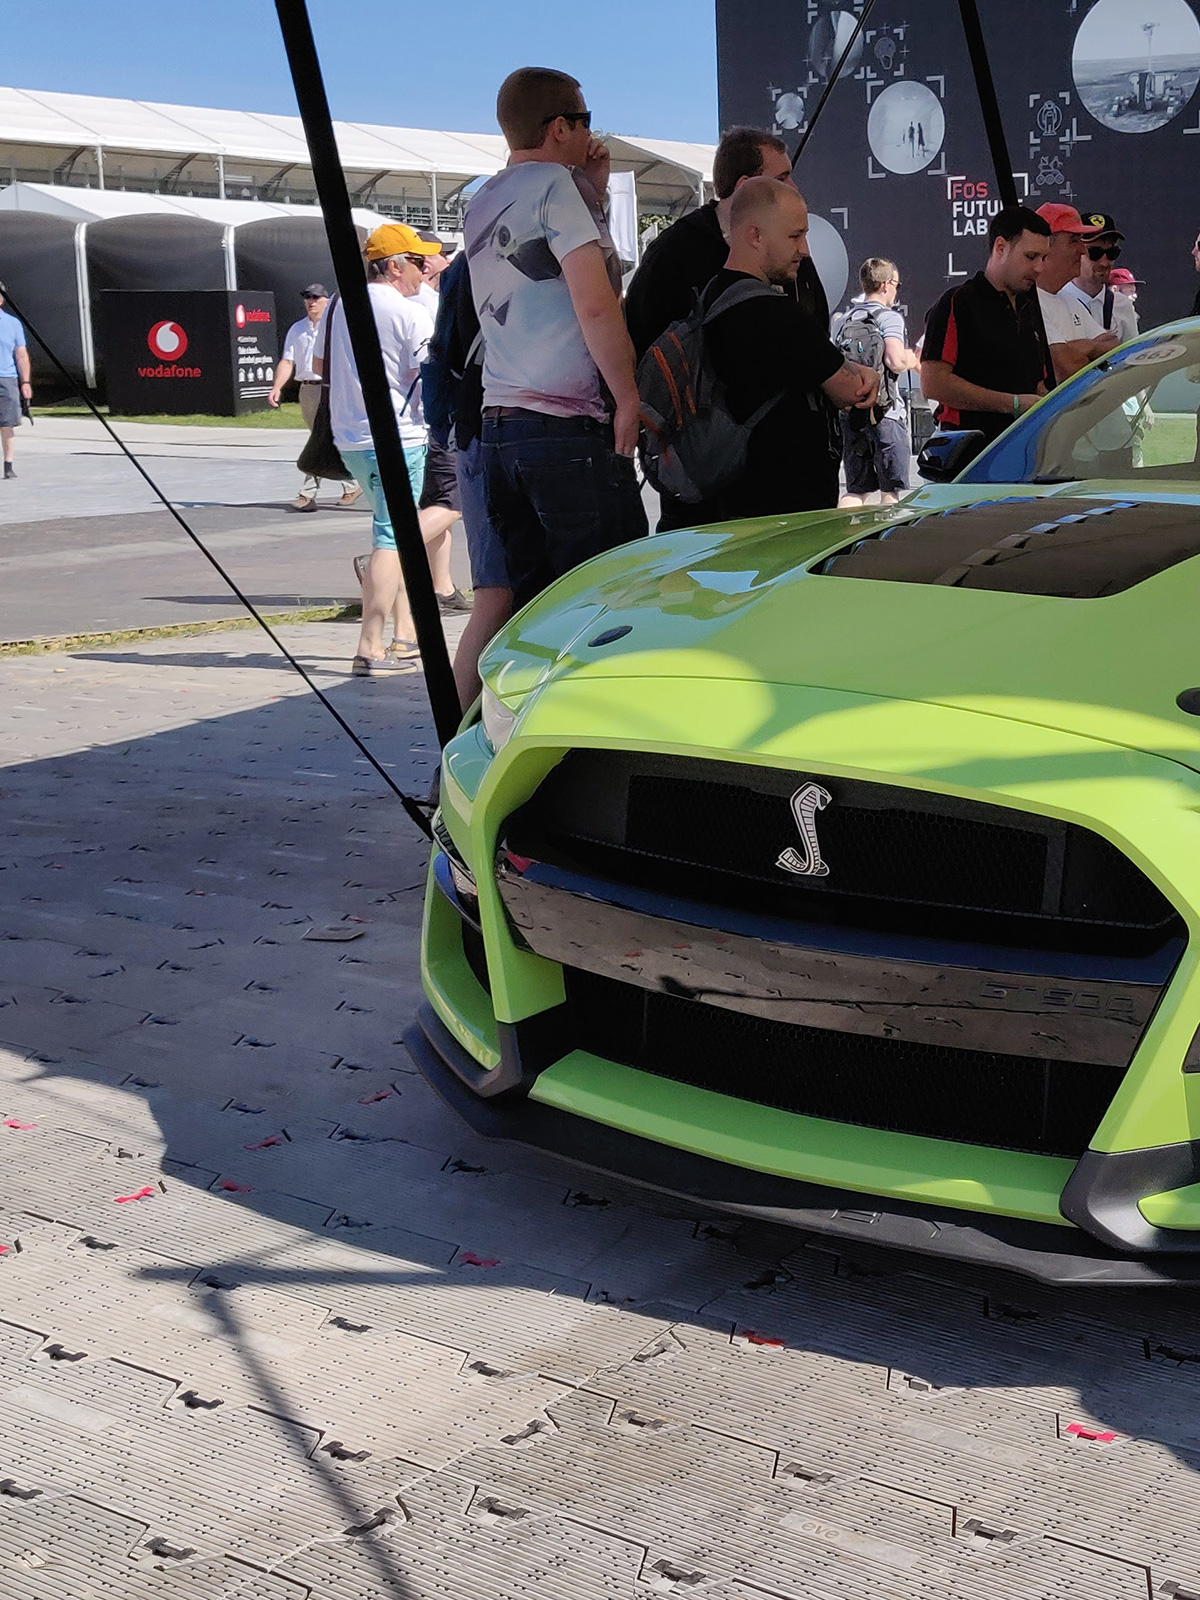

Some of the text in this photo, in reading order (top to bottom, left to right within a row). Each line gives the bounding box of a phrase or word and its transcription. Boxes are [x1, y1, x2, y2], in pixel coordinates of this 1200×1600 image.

[952, 181, 988, 199] FOS
[952, 199, 1023, 218] FUTU
[952, 218, 988, 236] LAB
[137, 364, 203, 378] vodafone
[801, 1522, 840, 1540] eve
